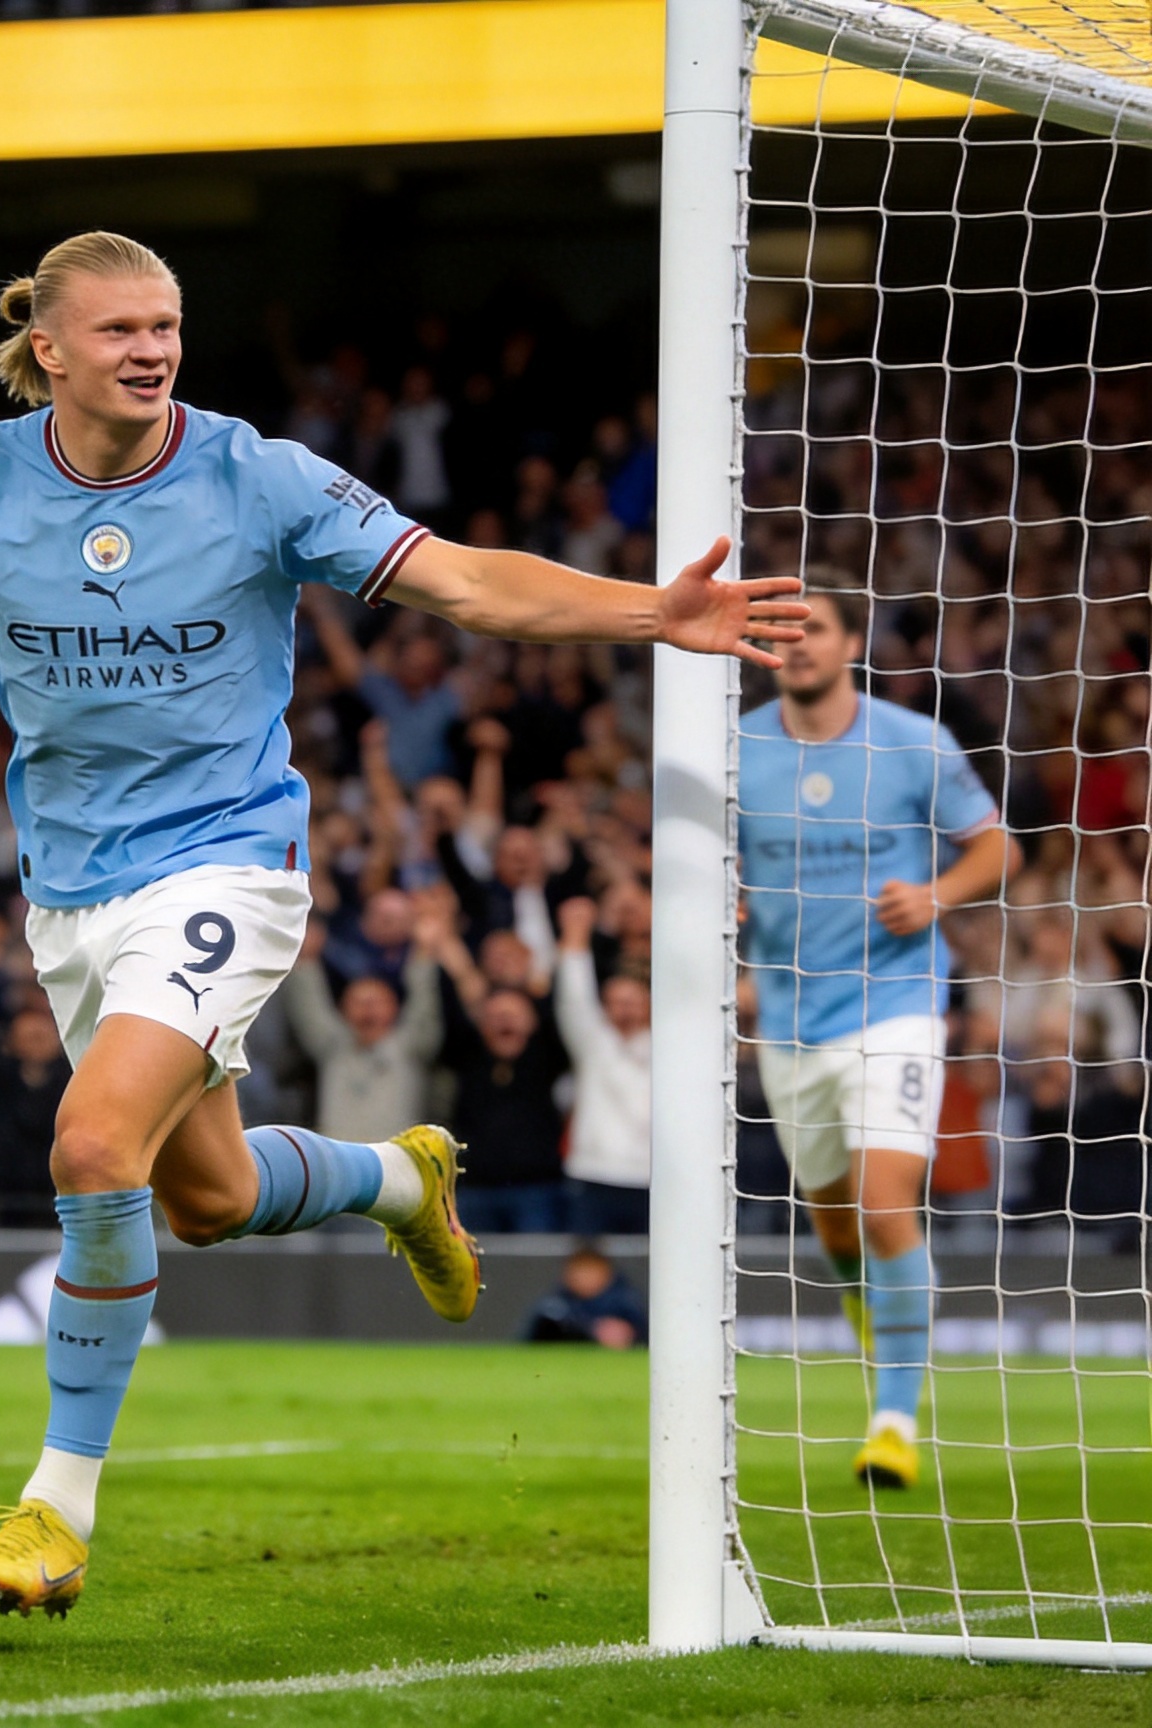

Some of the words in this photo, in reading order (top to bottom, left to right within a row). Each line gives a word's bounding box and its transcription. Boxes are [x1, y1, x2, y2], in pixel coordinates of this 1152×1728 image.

[7, 619, 226, 657] ETIHAD
[47, 662, 188, 688] AIRWAYS
[181, 910, 236, 974] 9
